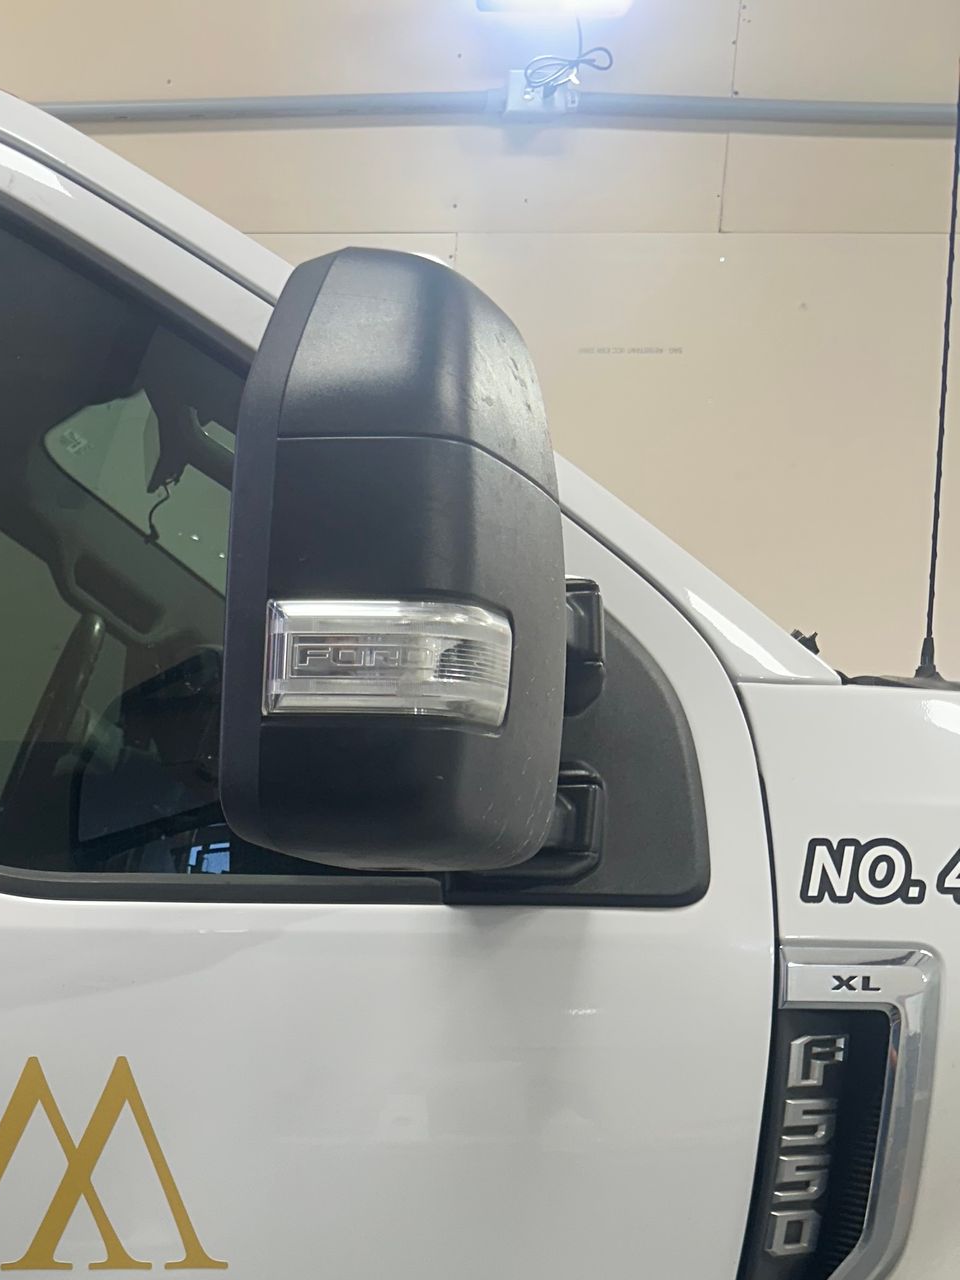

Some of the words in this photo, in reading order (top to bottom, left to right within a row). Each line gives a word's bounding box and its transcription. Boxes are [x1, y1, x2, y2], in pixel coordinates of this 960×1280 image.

[297, 643, 435, 668] FORD
[800, 837, 927, 905] NO.
[831, 975, 882, 992] XL
[764, 1034, 851, 1258] F550
